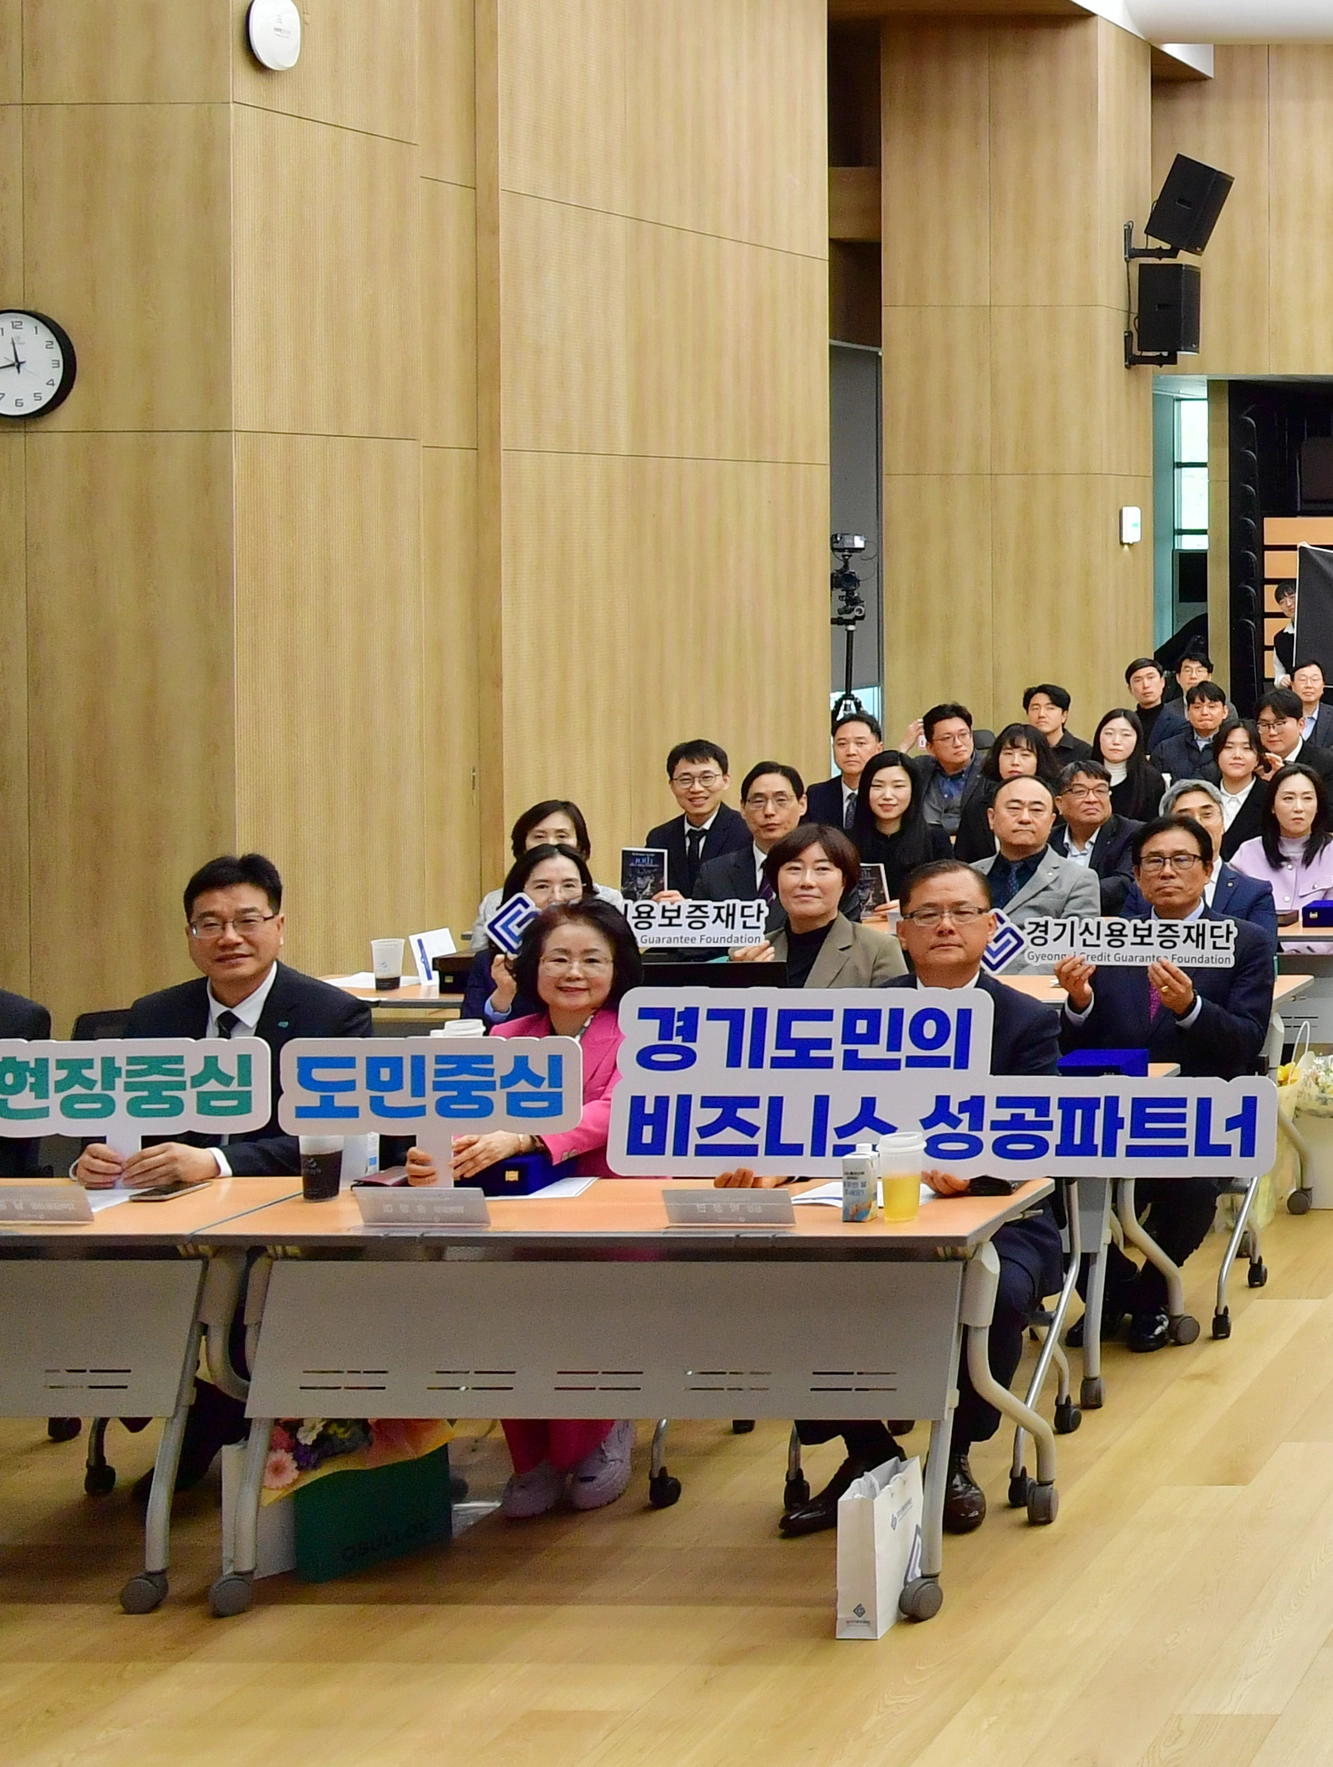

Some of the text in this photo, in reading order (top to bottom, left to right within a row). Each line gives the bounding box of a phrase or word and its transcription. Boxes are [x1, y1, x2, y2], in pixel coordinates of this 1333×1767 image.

[11, 321, 24, 330] 12
[45, 341, 54, 349] 2
[52, 360, 60, 368] 3
[46, 379, 55, 387] 4
[33, 393, 42, 401] 5
[15, 399, 24, 407] 6
[624, 903, 765, 930] 용보증재단
[640, 934, 761, 944] Guarantee Foundation
[1026, 920, 1234, 950] 경기신용보증재단
[1171, 954, 1231, 965] Foundation
[637, 1006, 973, 1072] 경기도민의
[0, 1053, 252, 1120] 현장중심
[294, 1053, 564, 1119] 도민중심
[625, 1093, 1258, 1160] 비즈니스 성공파트너
